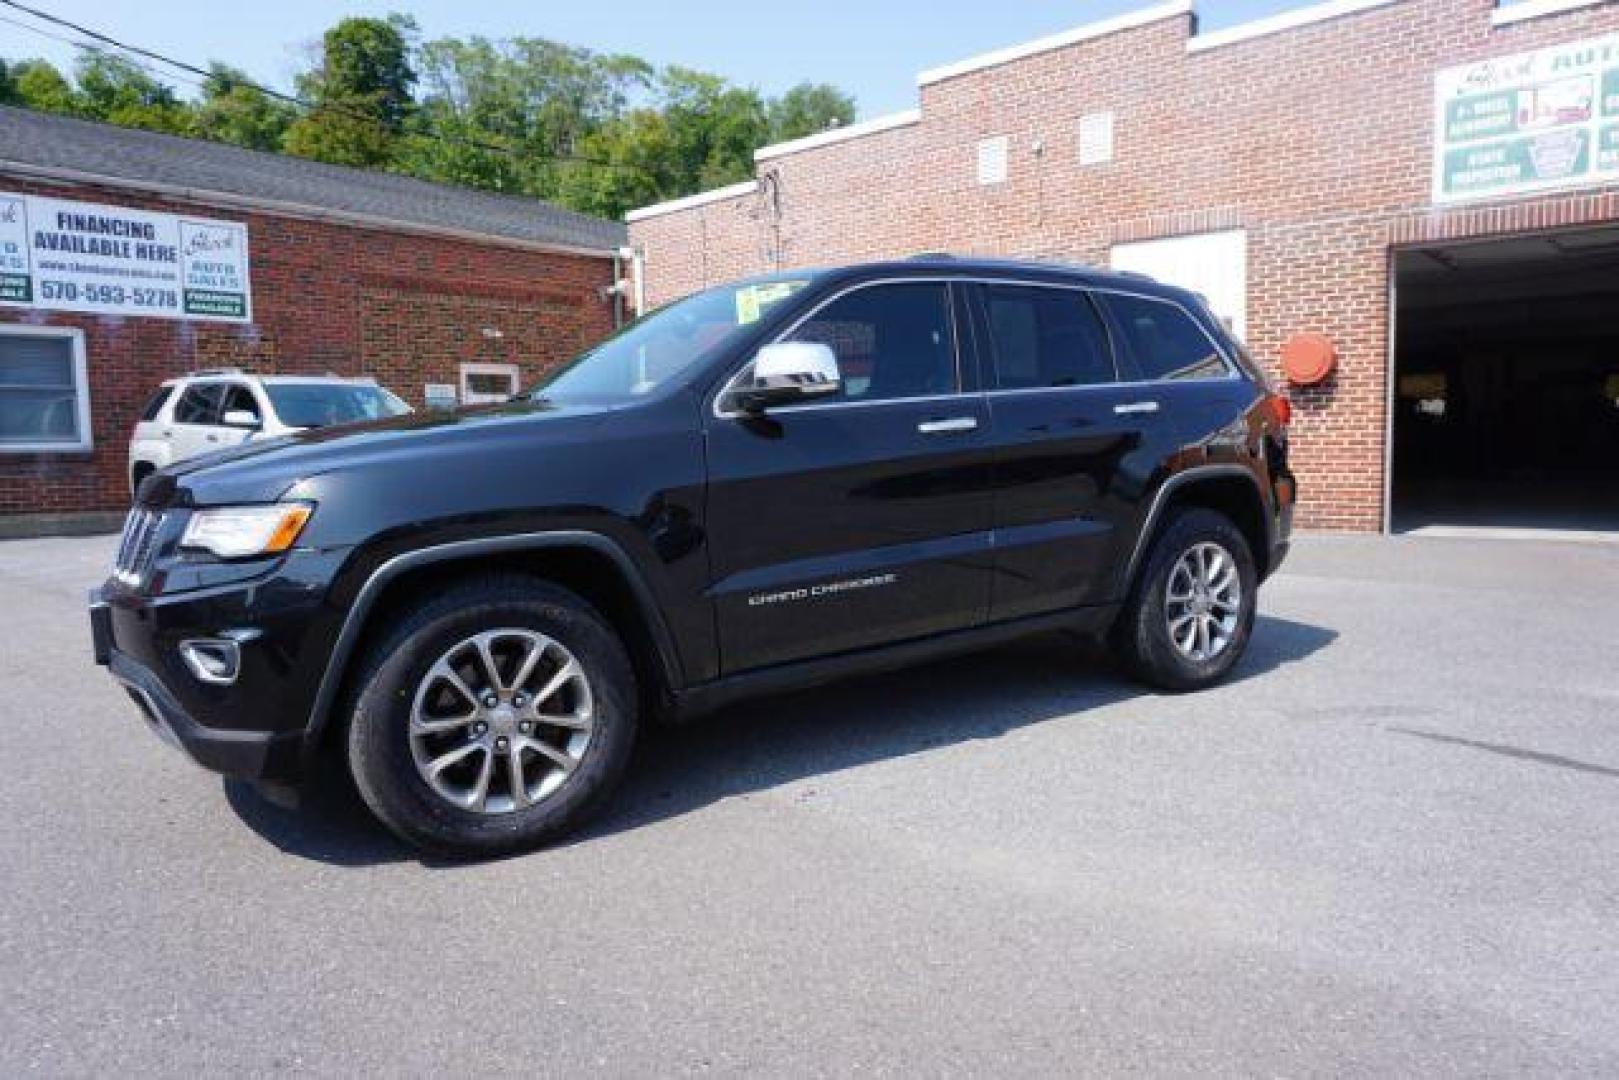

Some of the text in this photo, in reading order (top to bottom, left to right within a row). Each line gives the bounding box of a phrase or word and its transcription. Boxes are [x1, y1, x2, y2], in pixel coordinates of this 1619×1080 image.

[57, 211, 155, 240] FINANCING
[34, 231, 131, 258] AVAILABLE
[136, 243, 177, 263] HERE
